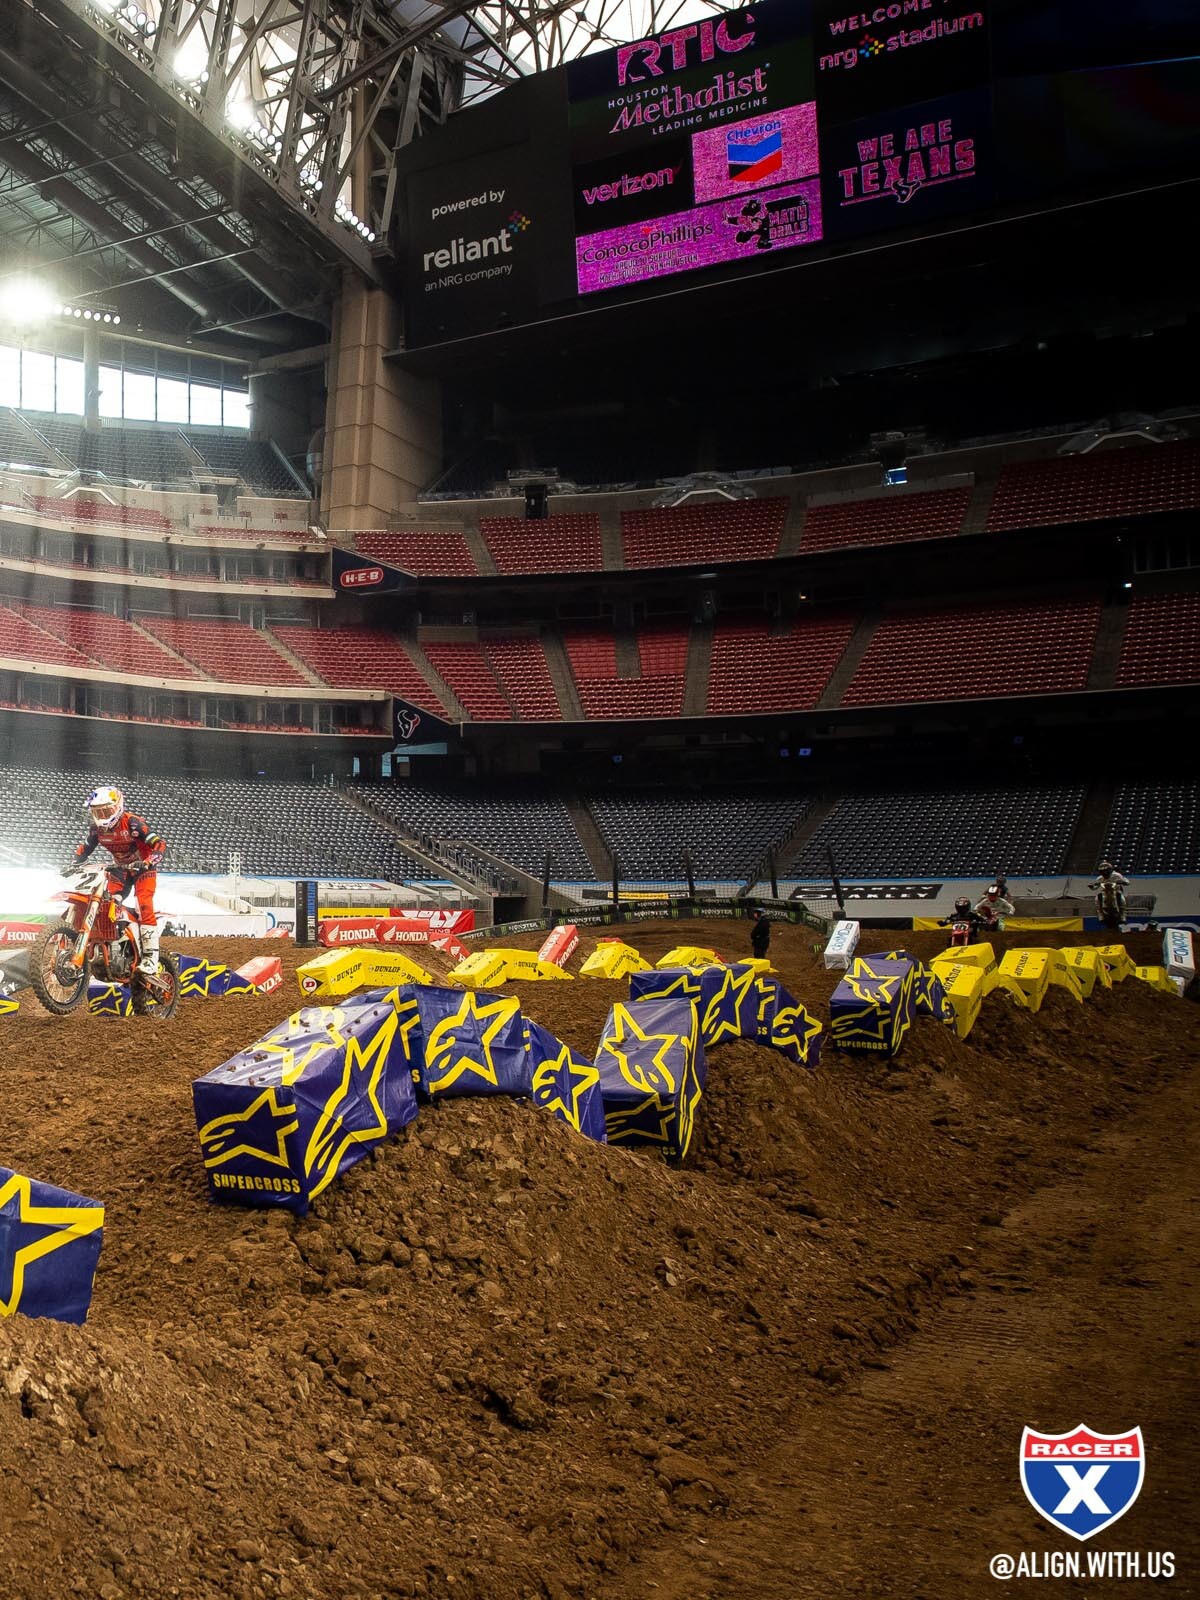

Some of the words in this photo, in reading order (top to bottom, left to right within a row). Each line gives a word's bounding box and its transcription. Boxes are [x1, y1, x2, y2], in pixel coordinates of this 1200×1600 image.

[829, 0, 933, 36] WELCOME
[617, 13, 756, 87] RTIC
[819, 48, 858, 70] nrg
[886, 12, 984, 52] stadium
[608, 84, 669, 110] HOUSTON
[609, 67, 768, 134] Methodist
[652, 114, 703, 136] LEADING
[708, 96, 769, 121] MEDICINE
[726, 119, 782, 142] Chevron
[857, 133, 894, 162] WE
[904, 119, 953, 151] ARE
[838, 138, 976, 199] TEXANS
[582, 165, 675, 205] verizon
[431, 192, 487, 220] powered
[489, 189, 506, 203] by
[423, 228, 513, 272] reliant
[582, 221, 713, 264] ConocoPhillips
[424, 281, 438, 292] an
[439, 273, 463, 289] NRG
[464, 263, 513, 279] company
[74, 872, 99, 890] 2
[633, 909, 669, 918] MONSTER
[701, 908, 733, 916] MONSTER
[7, 931, 39, 942] HON
[339, 928, 377, 942] HONDA
[394, 931, 429, 942] HONDA
[508, 922, 539, 931] MONSTER
[557, 936, 580, 967] HONDA
[336, 962, 363, 982] DUNLOP
[482, 963, 505, 986] DUNLOP
[518, 961, 538, 969] DUNLOP
[258, 972, 282, 993] NDA
[406, 974, 423, 985] DUN
[836, 1039, 889, 1050] SUPERCROSS
[213, 1172, 301, 1194] SUPERCROSS
